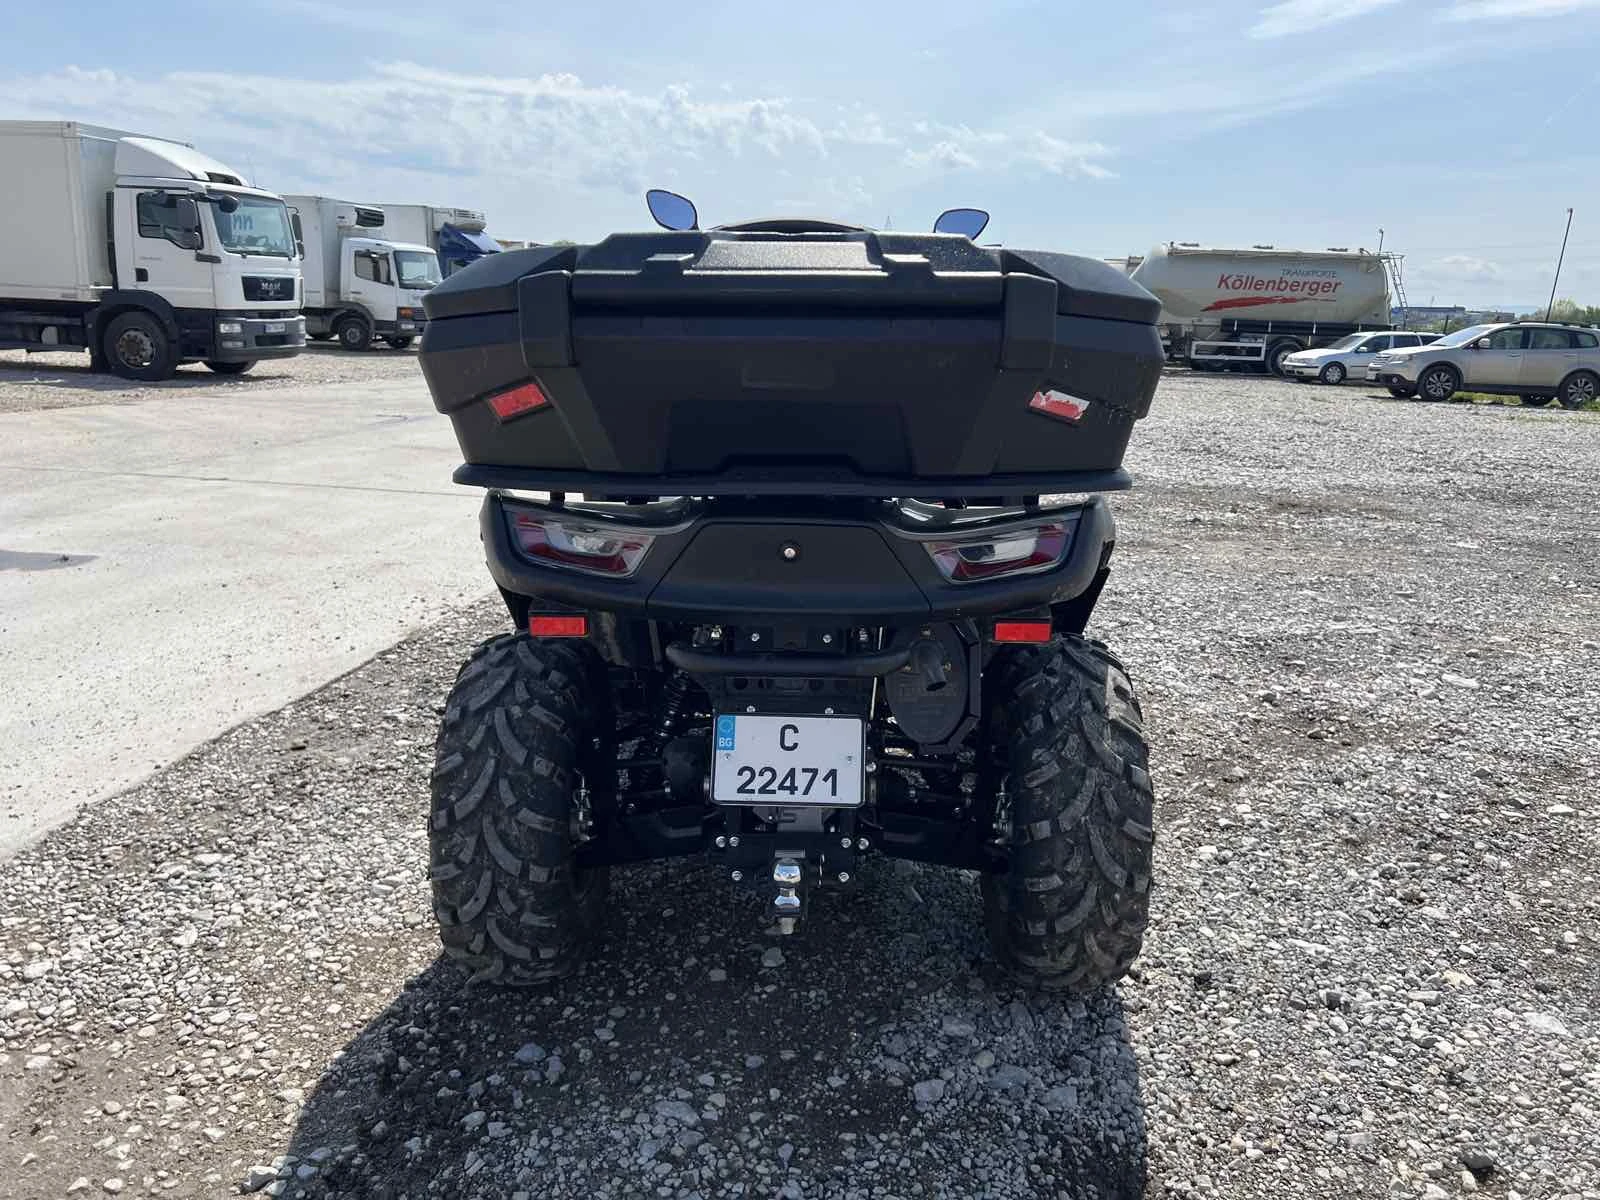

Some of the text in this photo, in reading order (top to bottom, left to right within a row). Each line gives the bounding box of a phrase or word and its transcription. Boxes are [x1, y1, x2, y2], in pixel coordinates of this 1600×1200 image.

[1217, 273, 1342, 296] Köllenberger
[718, 737, 733, 747] BG
[779, 723, 799, 752] C
[736, 765, 838, 797] 22471
